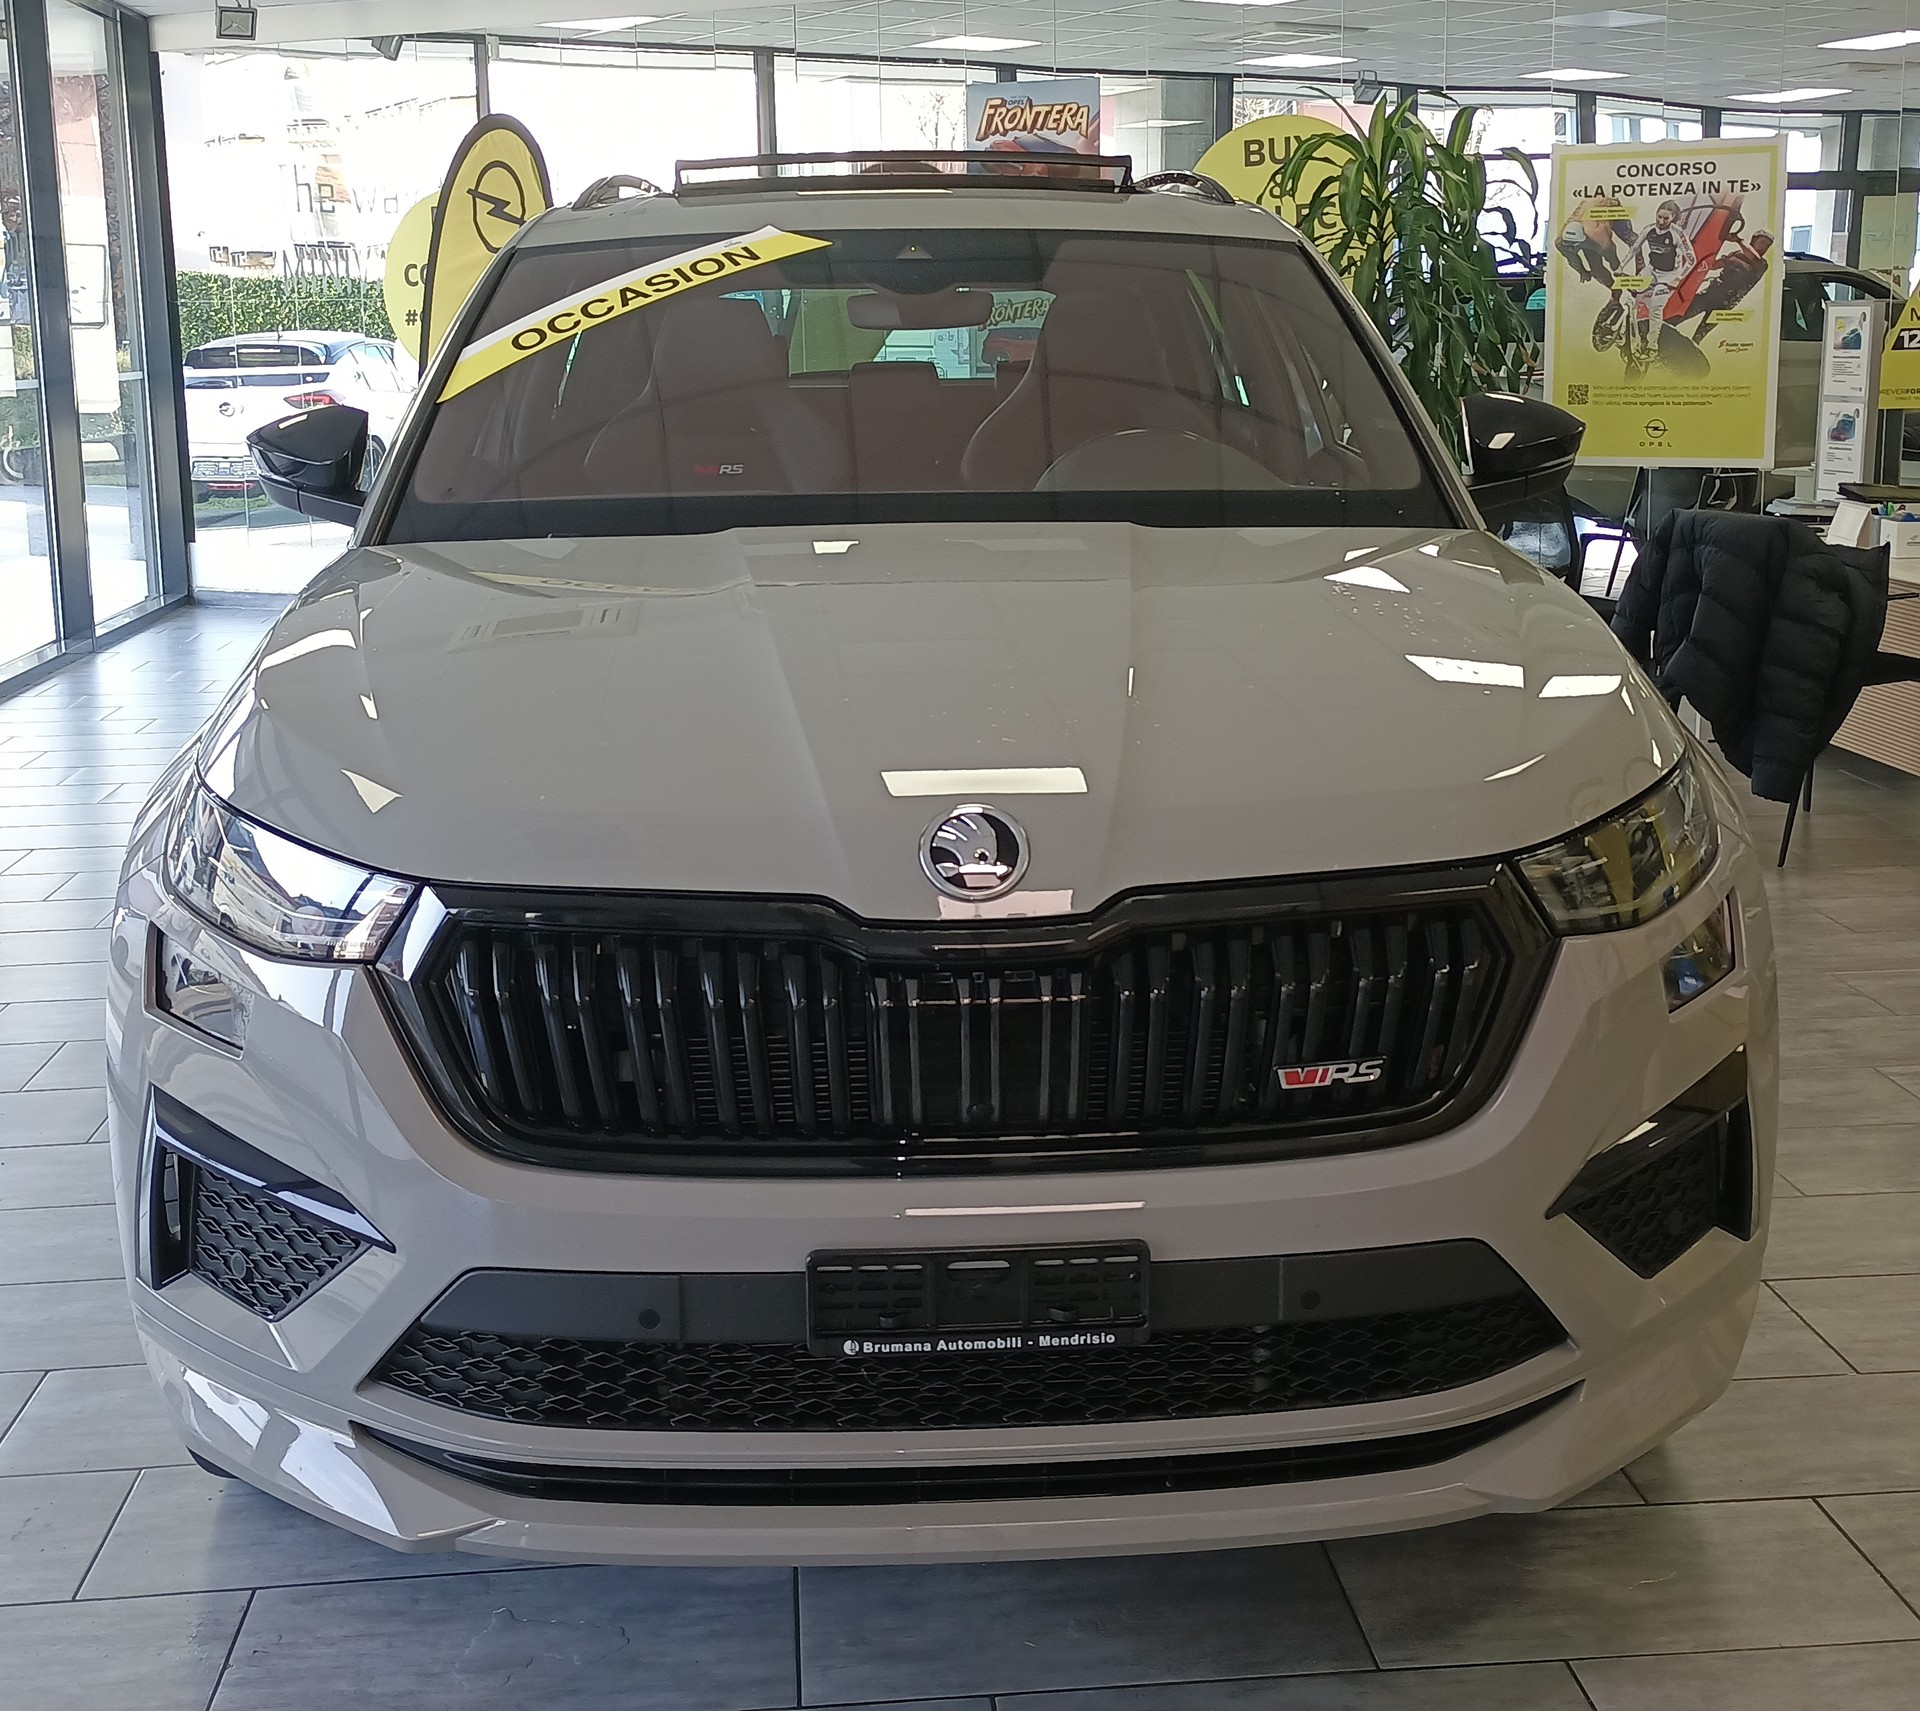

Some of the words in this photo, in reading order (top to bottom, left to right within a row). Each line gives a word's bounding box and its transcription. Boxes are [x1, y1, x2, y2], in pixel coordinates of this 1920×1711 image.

[975, 96, 1090, 142] FRONTERA
[1616, 161, 1717, 178] CONCORSO
[1572, 185, 1606, 199] «LA
[1611, 181, 1697, 198] POTENZA
[1702, 180, 1721, 194] IN
[1727, 179, 1762, 193] TE»
[510, 245, 762, 351] OCCASION
[987, 298, 1051, 326] RONTERA
[862, 1341, 932, 1354] Brumana
[936, 1336, 1023, 1351] Automobili
[1038, 1332, 1116, 1348] Mendrisio
